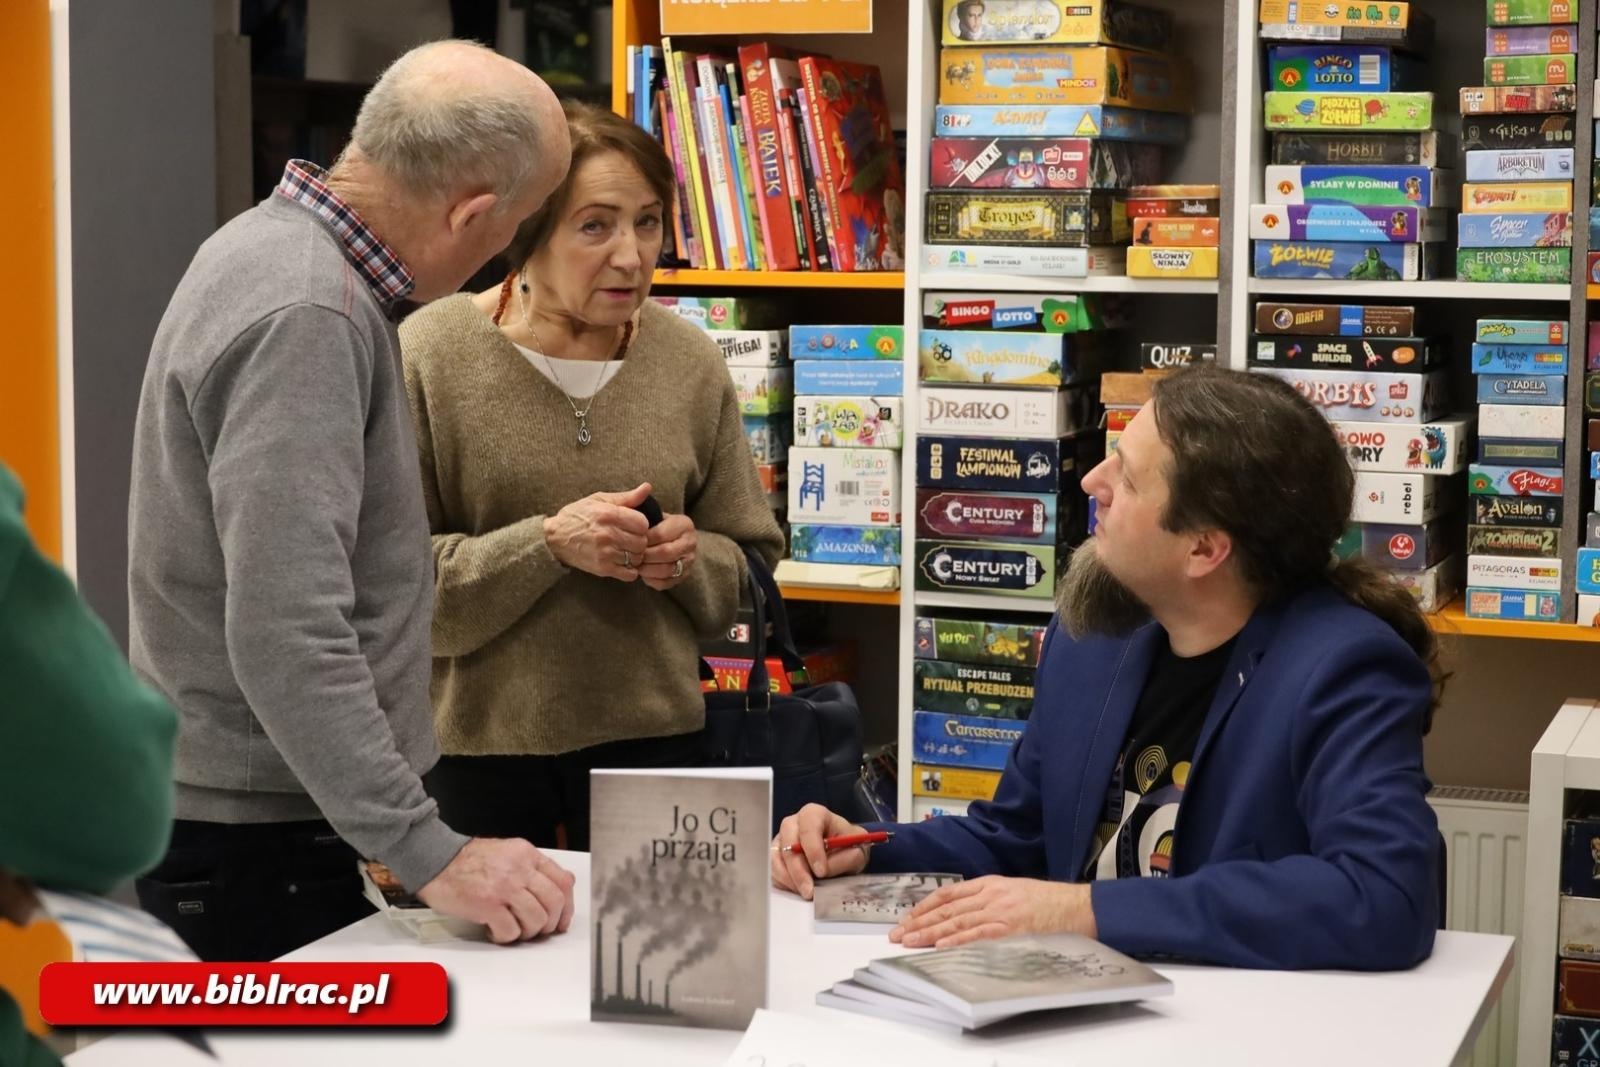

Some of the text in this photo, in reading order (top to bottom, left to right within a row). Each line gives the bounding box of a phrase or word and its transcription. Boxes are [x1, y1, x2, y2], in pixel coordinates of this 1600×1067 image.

[1314, 55, 1353, 69] BINGO
[1315, 73, 1353, 83] LOTTO
[750, 87, 764, 126] KSIĘGA
[758, 89, 772, 124] ZŁOTA
[1322, 110, 1361, 125] ŻÓŁWIE
[1327, 141, 1385, 161] HOBBIT
[759, 130, 781, 196] BAJEK
[1497, 154, 1545, 173] ARBORETUM
[1310, 181, 1399, 189] SYLABY W DOMINIE
[979, 207, 1035, 224] Troyes
[1270, 245, 1335, 265] ŻÓŁWIE
[1476, 252, 1560, 265] EKOSYSTEM
[952, 306, 1032, 322] BINGO LOTTO
[1295, 310, 1324, 324] MAFIA
[716, 338, 736, 346] MAMY
[721, 338, 762, 359] ZPIEGA!
[1318, 344, 1347, 353] SPACE
[1150, 345, 1191, 368] QUIZ
[1312, 353, 1352, 363] BUILDER
[1494, 380, 1547, 393] CYTADELA
[926, 396, 1010, 424] DRAKO
[960, 447, 1018, 464] FESTIWAL
[1402, 482, 1412, 515] rebel
[944, 500, 1024, 524] CENTURY
[1488, 499, 1543, 518] Avalon
[815, 542, 877, 554] AMAZONIA
[1541, 531, 1554, 552] 2
[932, 550, 1024, 582] CENTURY
[1472, 564, 1526, 574] PITAGORAS
[955, 574, 977, 582] NOWY
[957, 668, 1012, 682] ESCAPE TALES
[923, 677, 1035, 699] RYTUAŁ PRZEBUDZEN
[670, 805, 737, 837] Jo Ci
[651, 836, 737, 869] przaja
